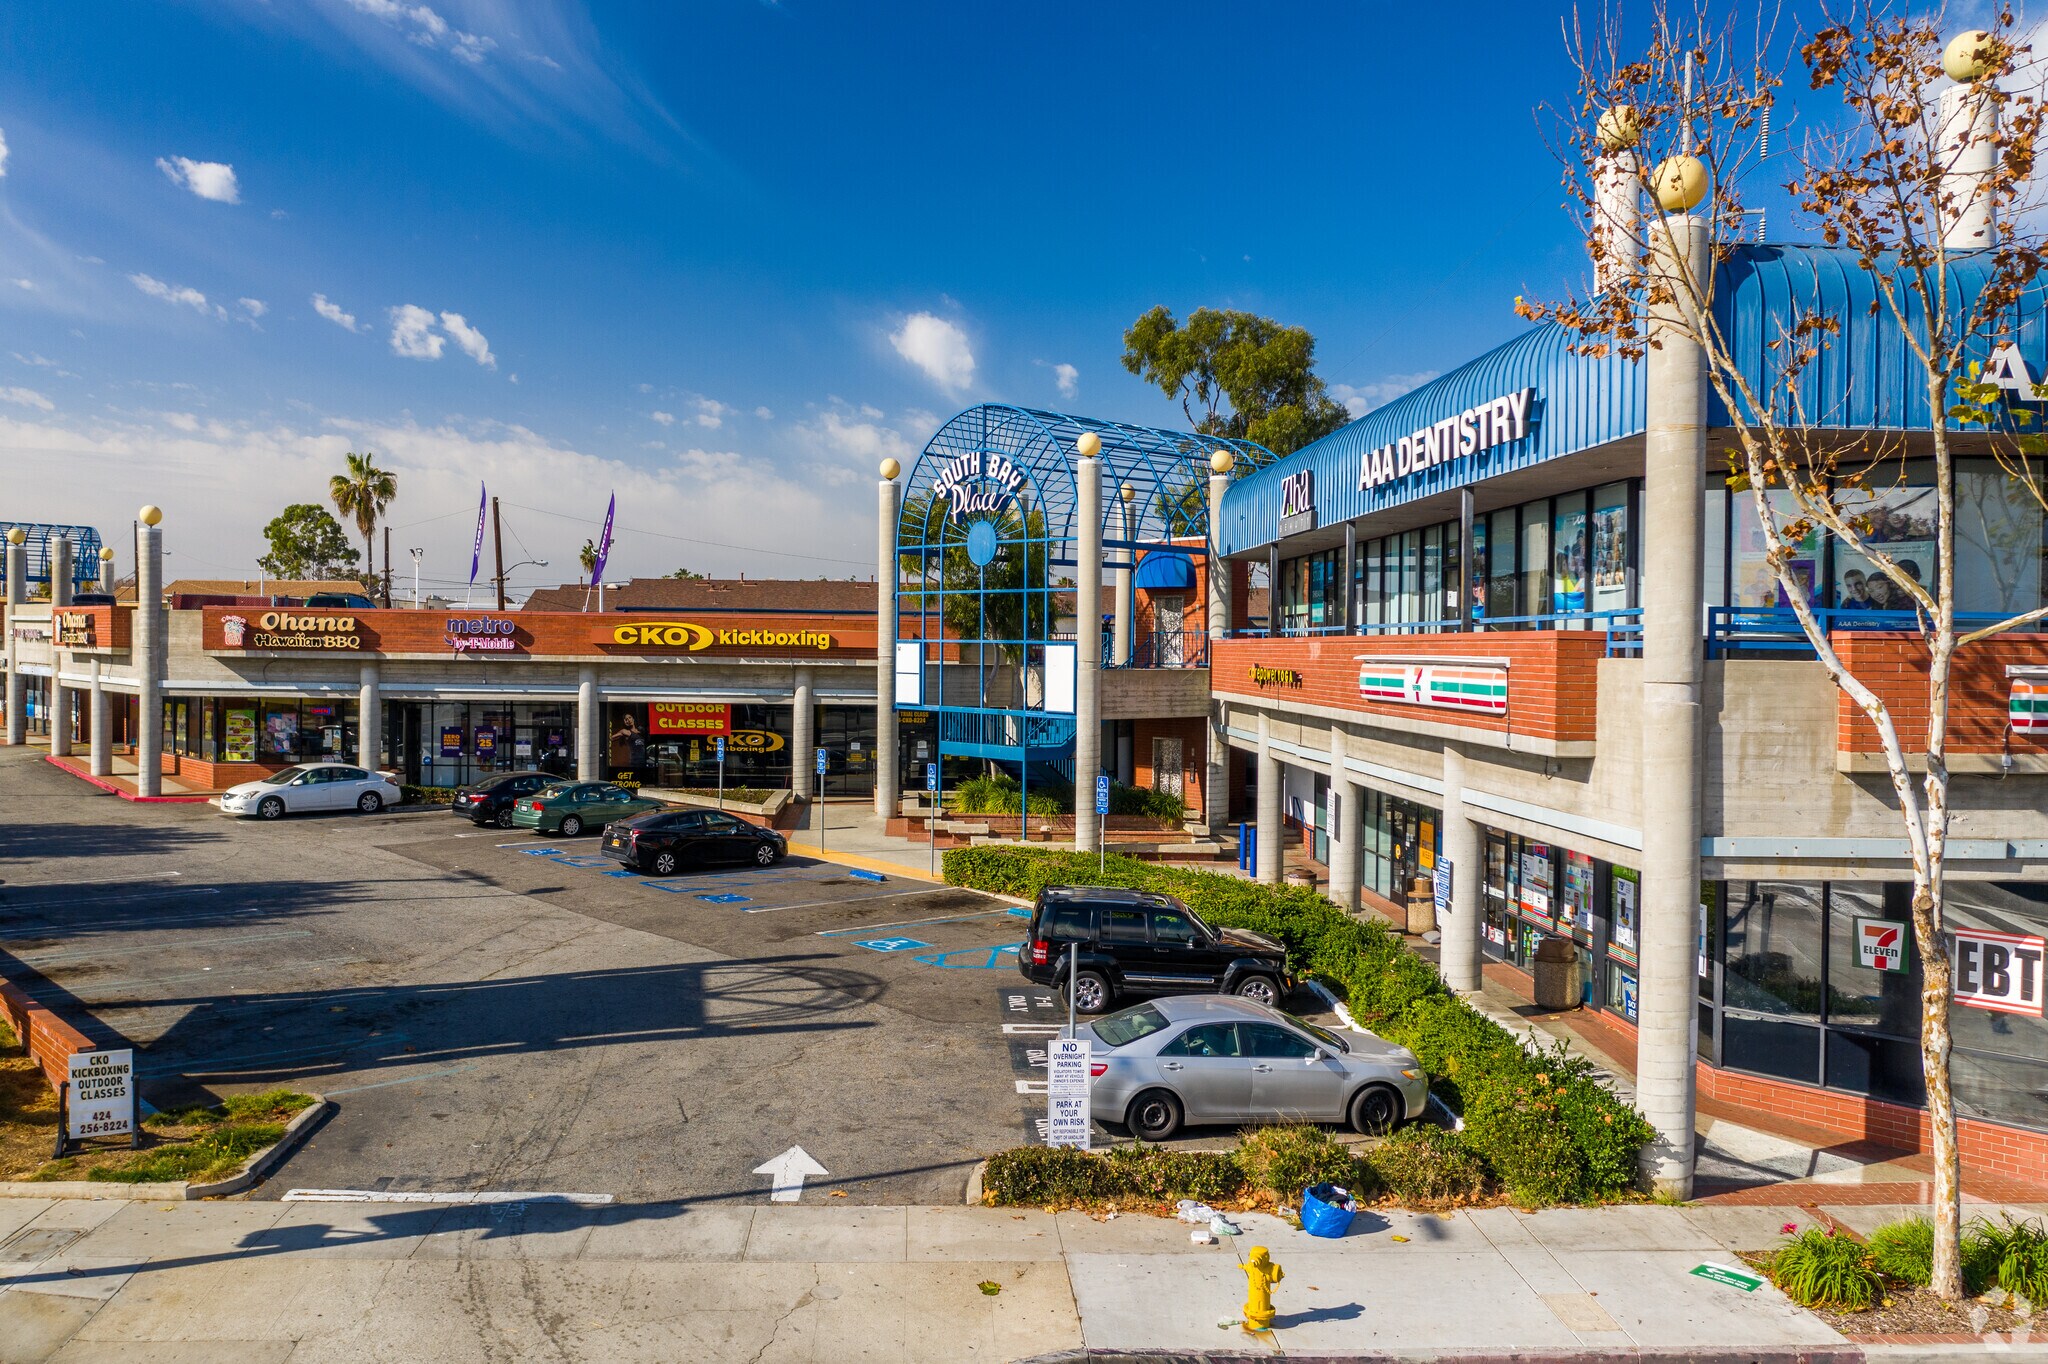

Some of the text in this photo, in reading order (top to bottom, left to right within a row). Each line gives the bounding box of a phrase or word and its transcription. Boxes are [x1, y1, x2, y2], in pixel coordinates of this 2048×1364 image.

[1358, 387, 1530, 492] AAA DENTISTRY
[933, 452, 1022, 499] SOUTH BAY
[951, 484, 1012, 524] Place
[260, 612, 356, 631] Ohana
[446, 615, 515, 634] metro
[254, 633, 360, 649] Hawaiian BBQ
[453, 637, 515, 651] by T-Mobile
[613, 625, 830, 650] CKO kickboxing
[655, 703, 725, 713] OUTDOOR
[658, 717, 725, 729] CLASSES
[706, 745, 764, 753] kikboxing
[617, 772, 634, 780] GET
[1957, 940, 2042, 1002] EBT
[1062, 1043, 1078, 1052] NO
[89, 1055, 109, 1066] CKO
[72, 1064, 130, 1078] KICKBOXING
[78, 1076, 123, 1090] OUTDOOR
[81, 1087, 126, 1101] CLASSES
[1056, 1100, 1073, 1108] PARK
[92, 1110, 112, 1121] 424
[1060, 1109, 1078, 1117] YOUR
[80, 1119, 128, 1134] 256-8224
[1053, 1118, 1085, 1126] OWN RISK
